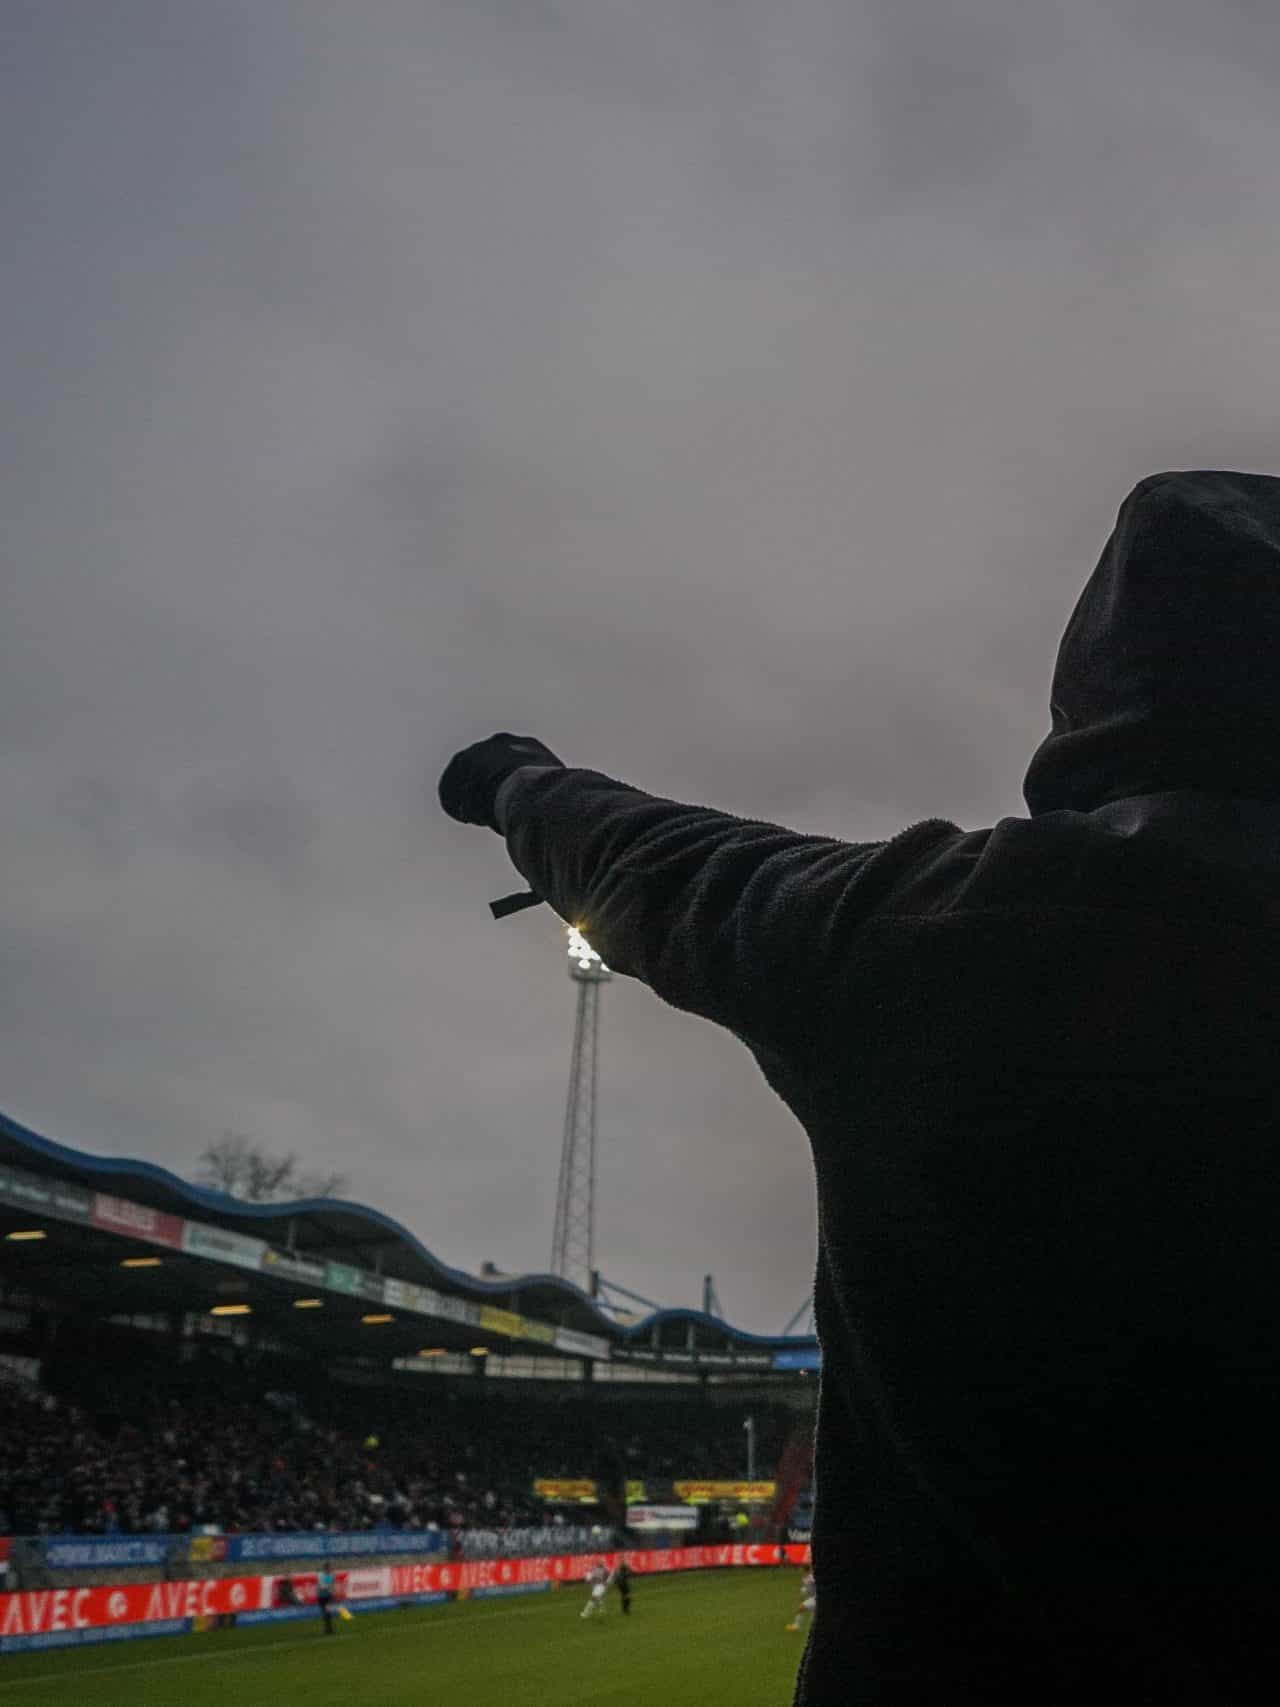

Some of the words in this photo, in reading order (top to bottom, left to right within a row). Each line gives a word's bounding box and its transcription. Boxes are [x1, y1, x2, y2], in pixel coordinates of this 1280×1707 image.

[391, 1563, 433, 1595] AVEC
[2, 1588, 92, 1636] AVEC
[144, 1580, 218, 1622] AVEC
